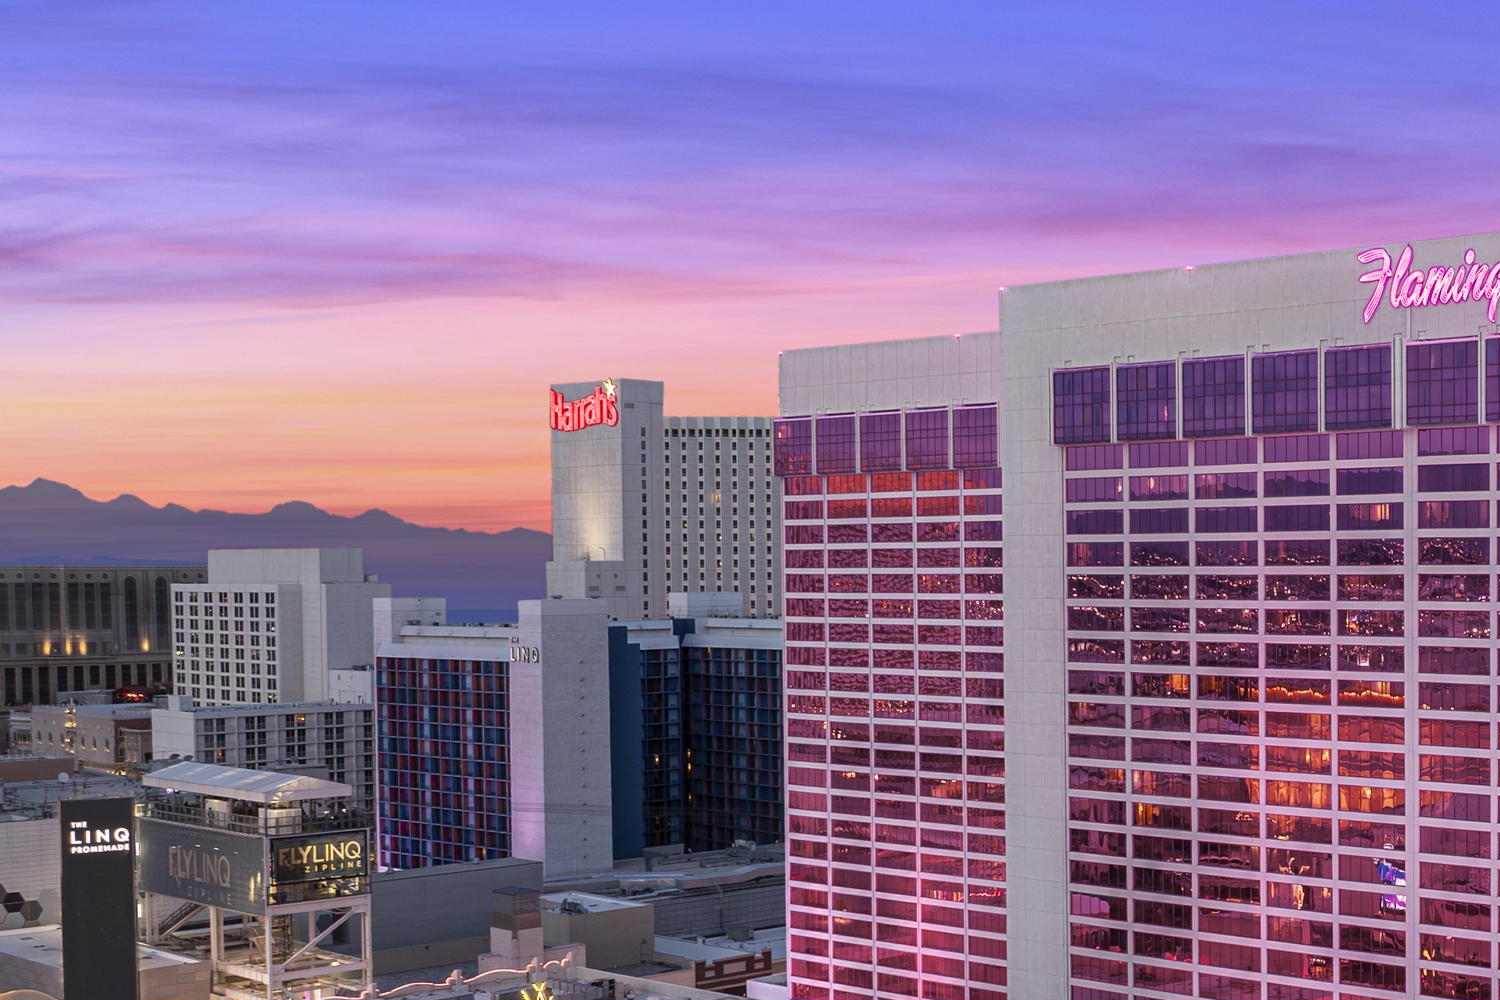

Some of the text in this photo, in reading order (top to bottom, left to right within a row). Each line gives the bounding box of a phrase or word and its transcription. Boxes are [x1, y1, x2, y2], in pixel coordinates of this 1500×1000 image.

[510, 646, 540, 663] LINQ
[70, 827, 130, 845] LINQ
[70, 843, 130, 854] PROMENADE
[278, 840, 362, 868] FLYLINQ
[169, 845, 231, 888] FLYLINQ
[304, 860, 362, 873] ZIPLINE
